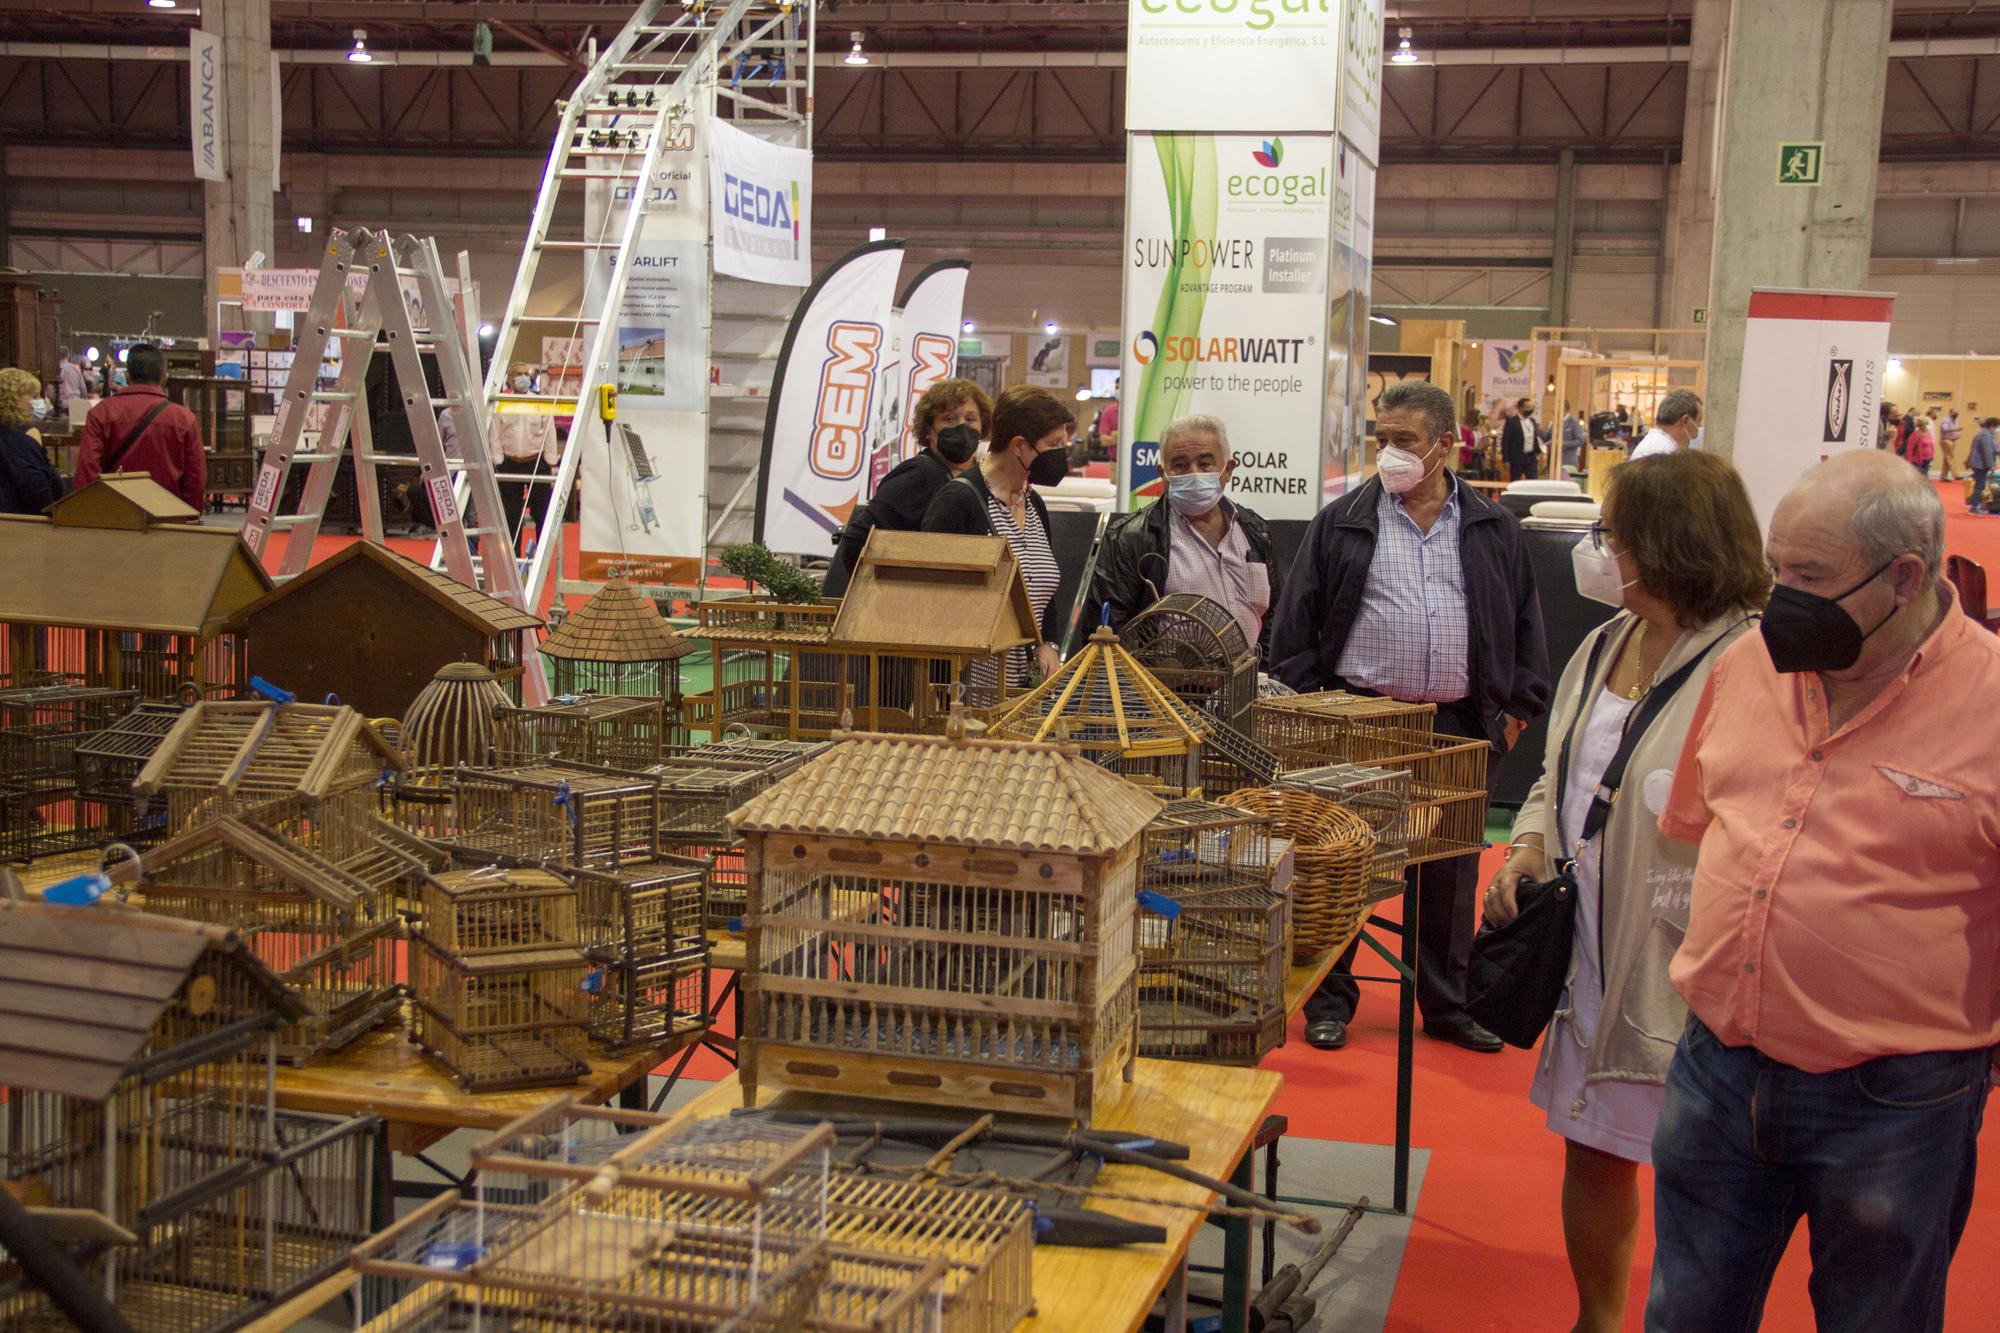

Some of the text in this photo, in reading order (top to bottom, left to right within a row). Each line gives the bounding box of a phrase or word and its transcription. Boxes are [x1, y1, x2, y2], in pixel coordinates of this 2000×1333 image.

[1138, 35, 1200, 46] Autoconsumo
[1203, 39, 1209, 48] y
[1211, 35, 1255, 46] Eficiencia
[660, 171, 691, 181] Oficial
[614, 186, 677, 200] GDA
[1228, 167, 1326, 205] ecogal
[725, 172, 791, 229] GEDA
[609, 255, 678, 267] SARLIFT
[1134, 238, 1254, 269] SUNPOWER
[1269, 248, 1315, 263] Platinum
[1268, 269, 1312, 283] Installer
[1180, 283, 1253, 294] ADVANTAGE PROGRAM
[1164, 374, 1302, 397] power to the people
[809, 320, 884, 481] CEM
[1859, 359, 1875, 448] solutions
[1136, 448, 1160, 466] SM
[1232, 451, 1288, 469] SOLAR
[255, 471, 271, 506] GEDA
[1231, 476, 1307, 494] PARTNER
[439, 479, 454, 518] GEDA
